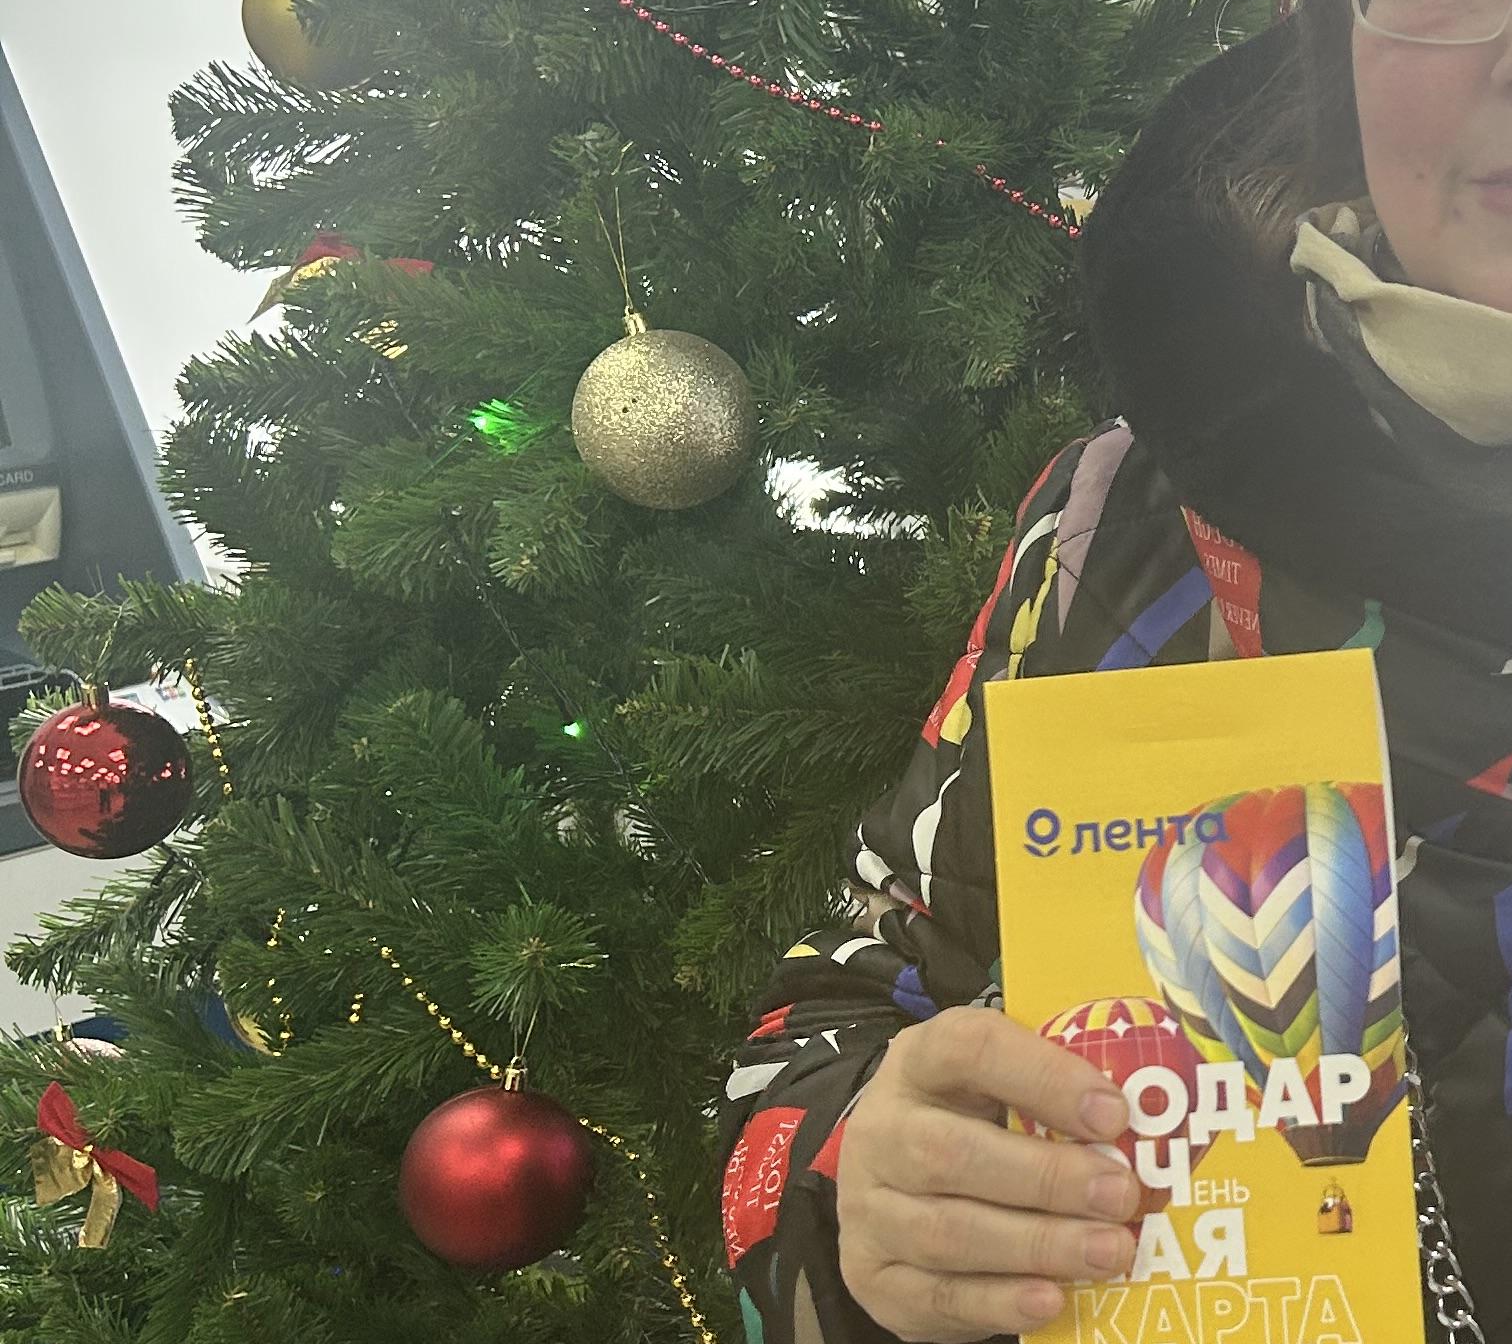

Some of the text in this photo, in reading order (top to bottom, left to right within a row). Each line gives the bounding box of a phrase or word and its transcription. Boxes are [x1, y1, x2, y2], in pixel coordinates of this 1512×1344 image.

[1071, 811, 1231, 854] лента
[1103, 1053, 1371, 1146] ОДАР
[1073, 1207, 1249, 1285] АЯ
